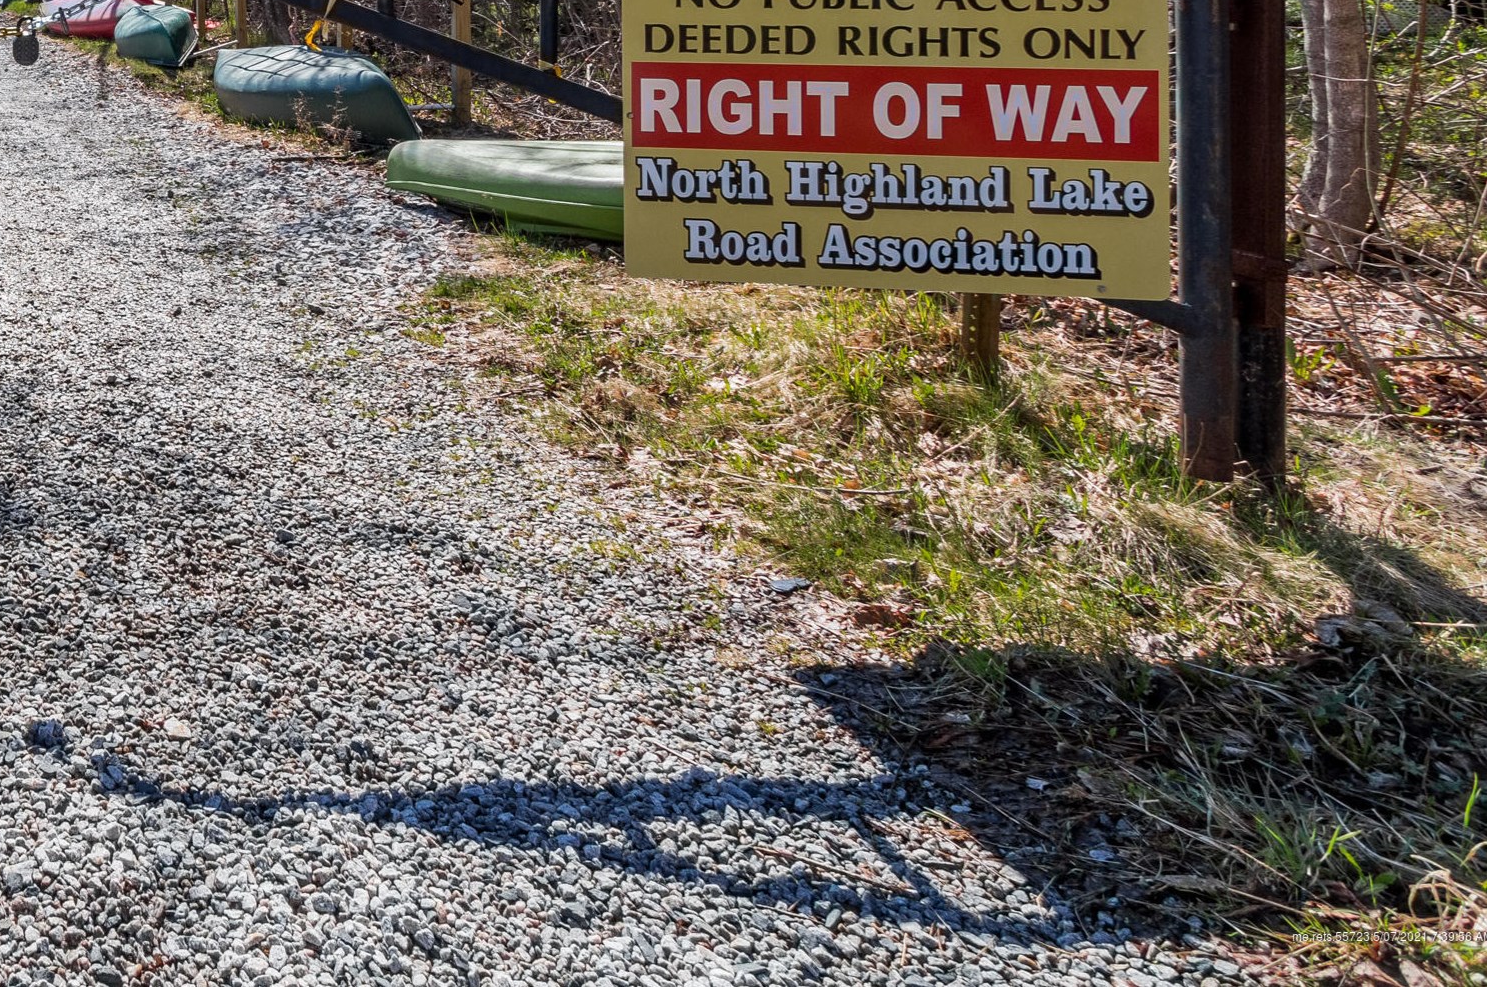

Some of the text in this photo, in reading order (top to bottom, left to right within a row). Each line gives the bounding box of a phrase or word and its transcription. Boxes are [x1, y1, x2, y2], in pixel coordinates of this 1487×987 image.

[644, 23, 1146, 60] DEEDED RIGHTS ONLY
[639, 77, 1149, 144] RIGHT OF WAY
[635, 156, 1154, 220] North Highland Lake
[684, 218, 1102, 280] Road Association
